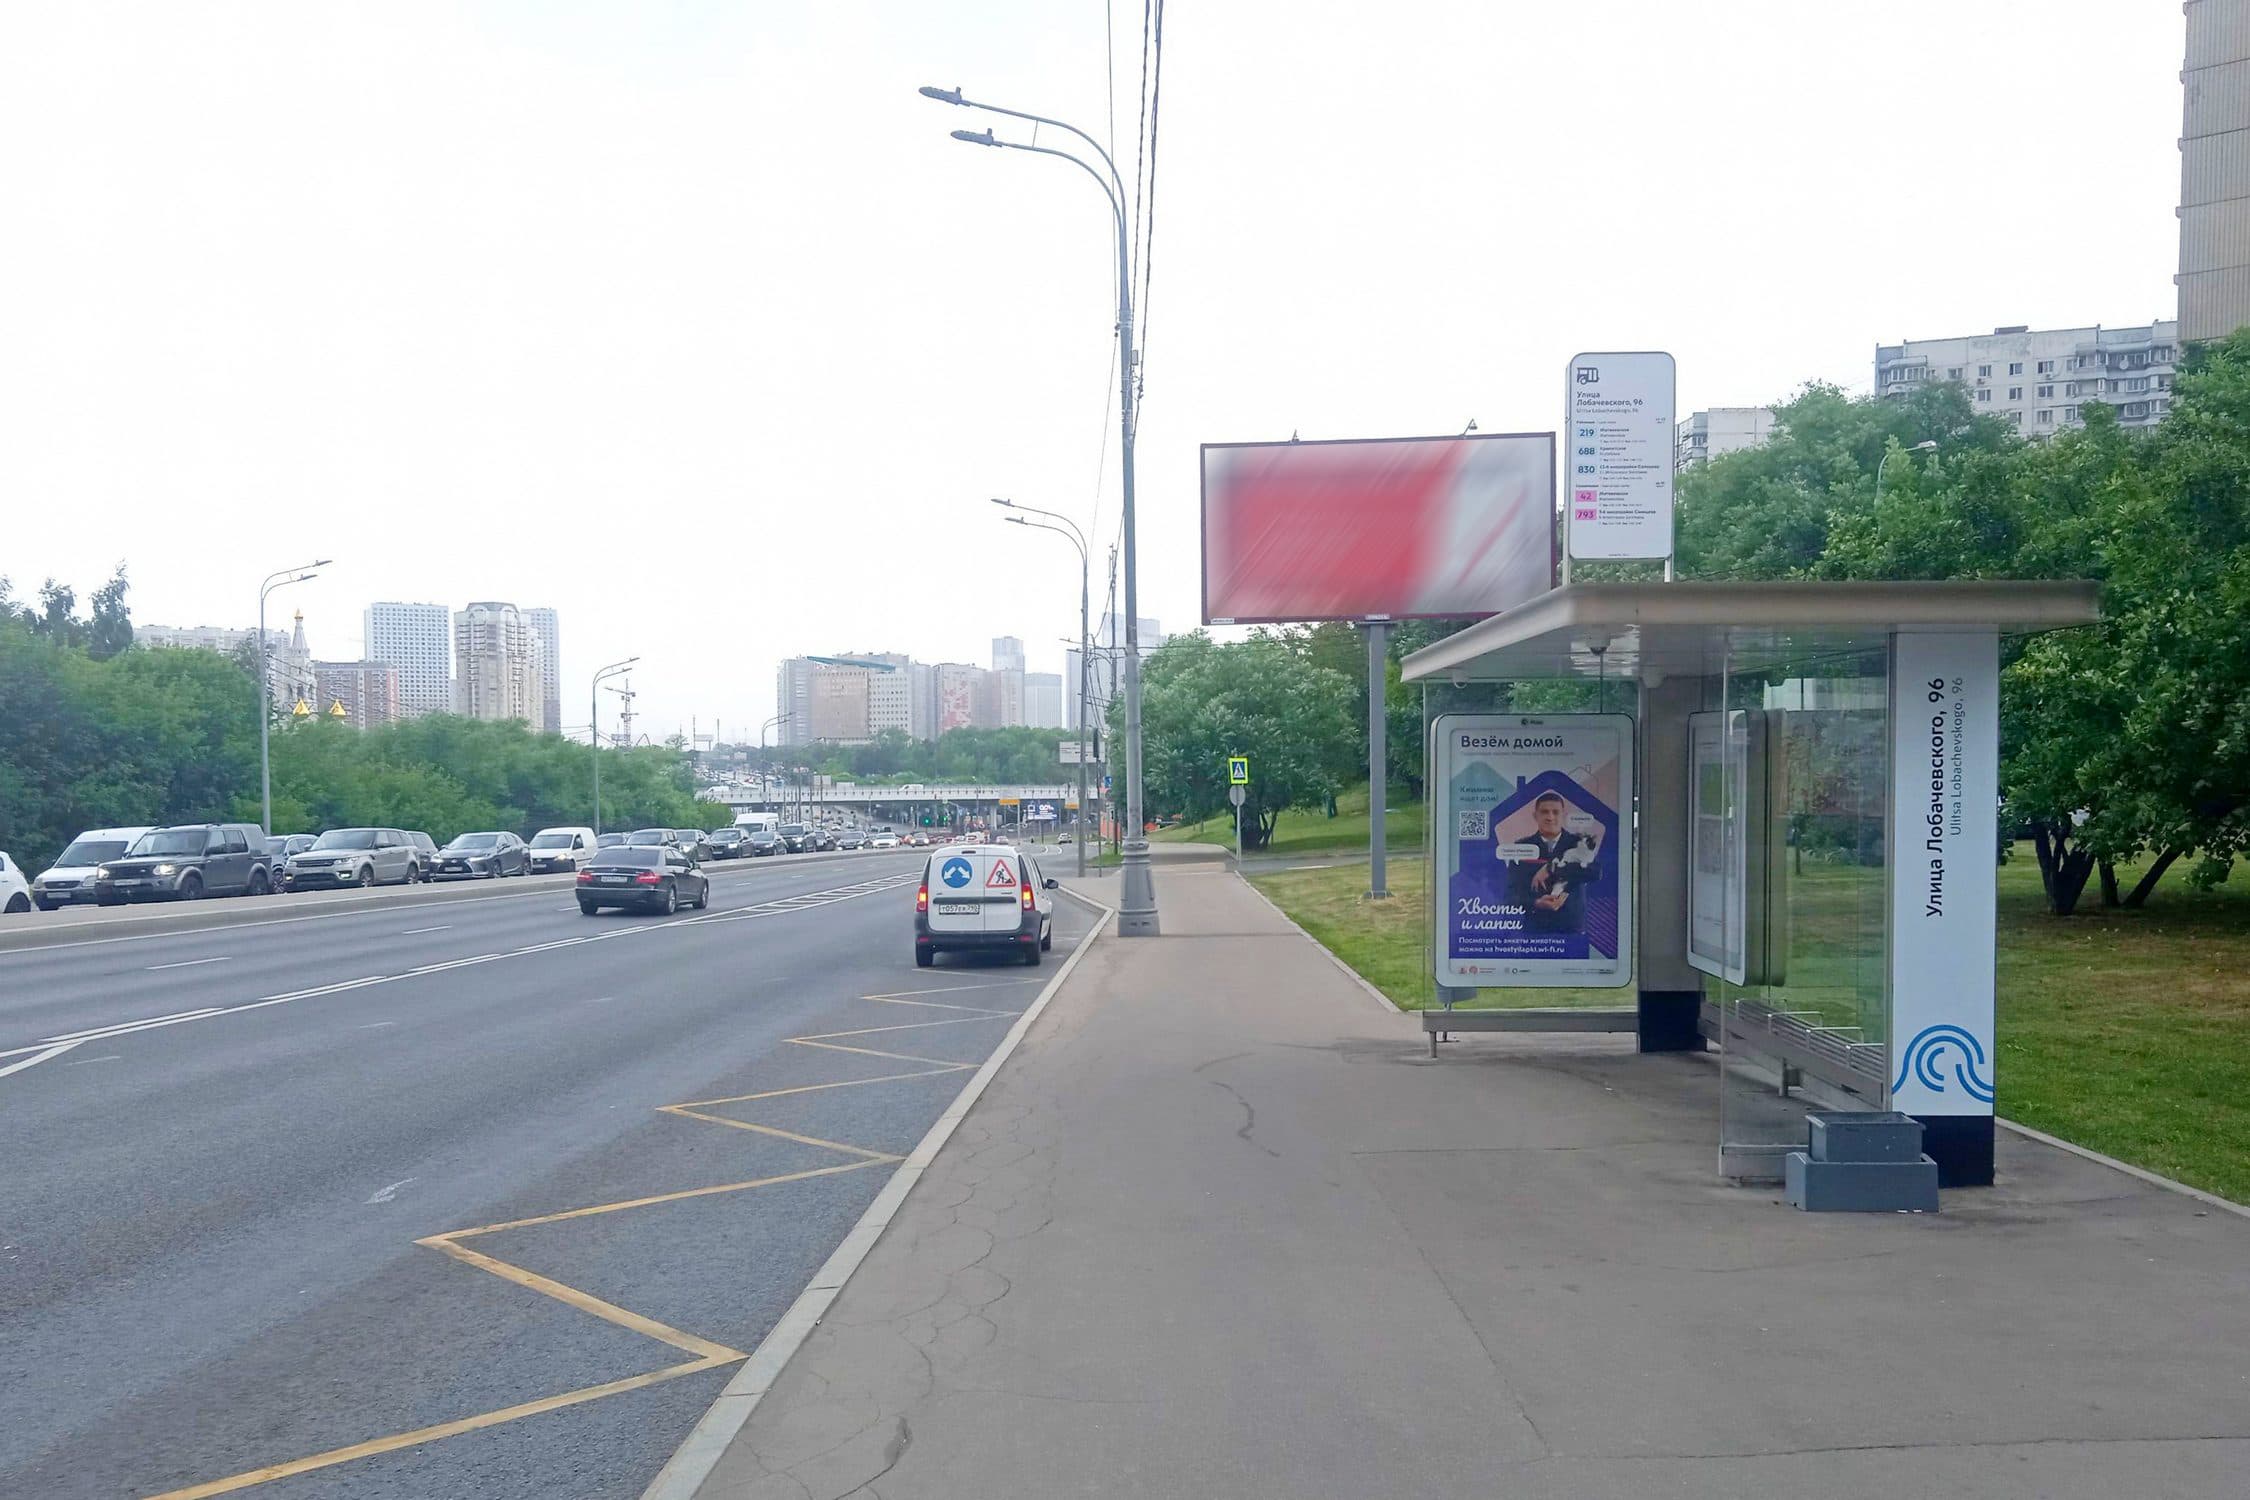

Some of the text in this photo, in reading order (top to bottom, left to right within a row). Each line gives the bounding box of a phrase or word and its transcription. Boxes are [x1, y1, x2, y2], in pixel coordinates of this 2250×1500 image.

[1576, 391, 1600, 399] Улица
[1580, 429, 1595, 437] 219
[1578, 447, 1595, 455] 688
[1460, 735, 1563, 748] Везём домой
[1950, 677, 1965, 836] Ulitsa Lobachevskogo, 96
[1926, 678, 1947, 917] Улица Лобачевского, 96
[1458, 897, 1526, 915] Хвосты
[1461, 919, 1524, 930] и лапки
